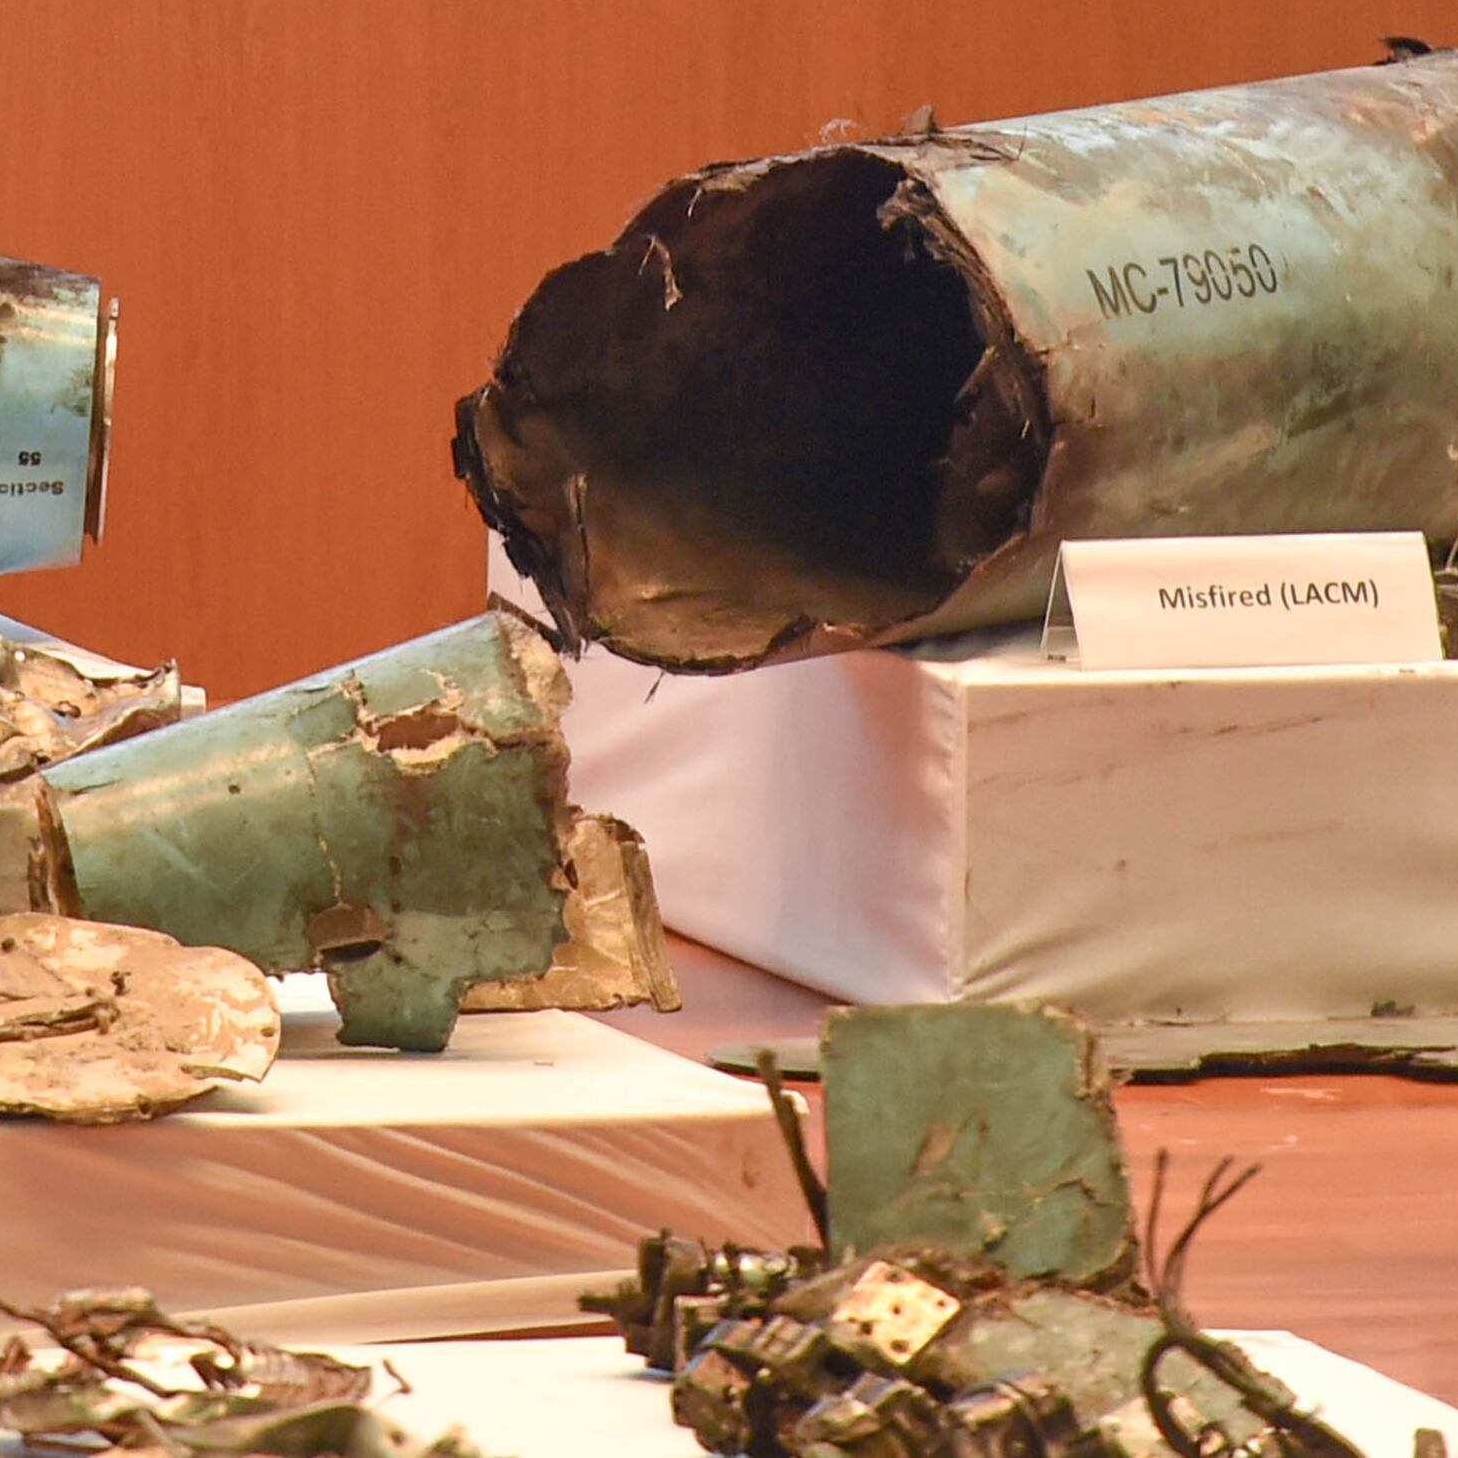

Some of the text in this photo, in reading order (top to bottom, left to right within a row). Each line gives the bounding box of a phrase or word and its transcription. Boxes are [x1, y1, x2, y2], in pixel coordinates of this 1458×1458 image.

[1086, 243, 1278, 320] MC-79050
[1158, 578, 1380, 611] Misfired (LACM)
